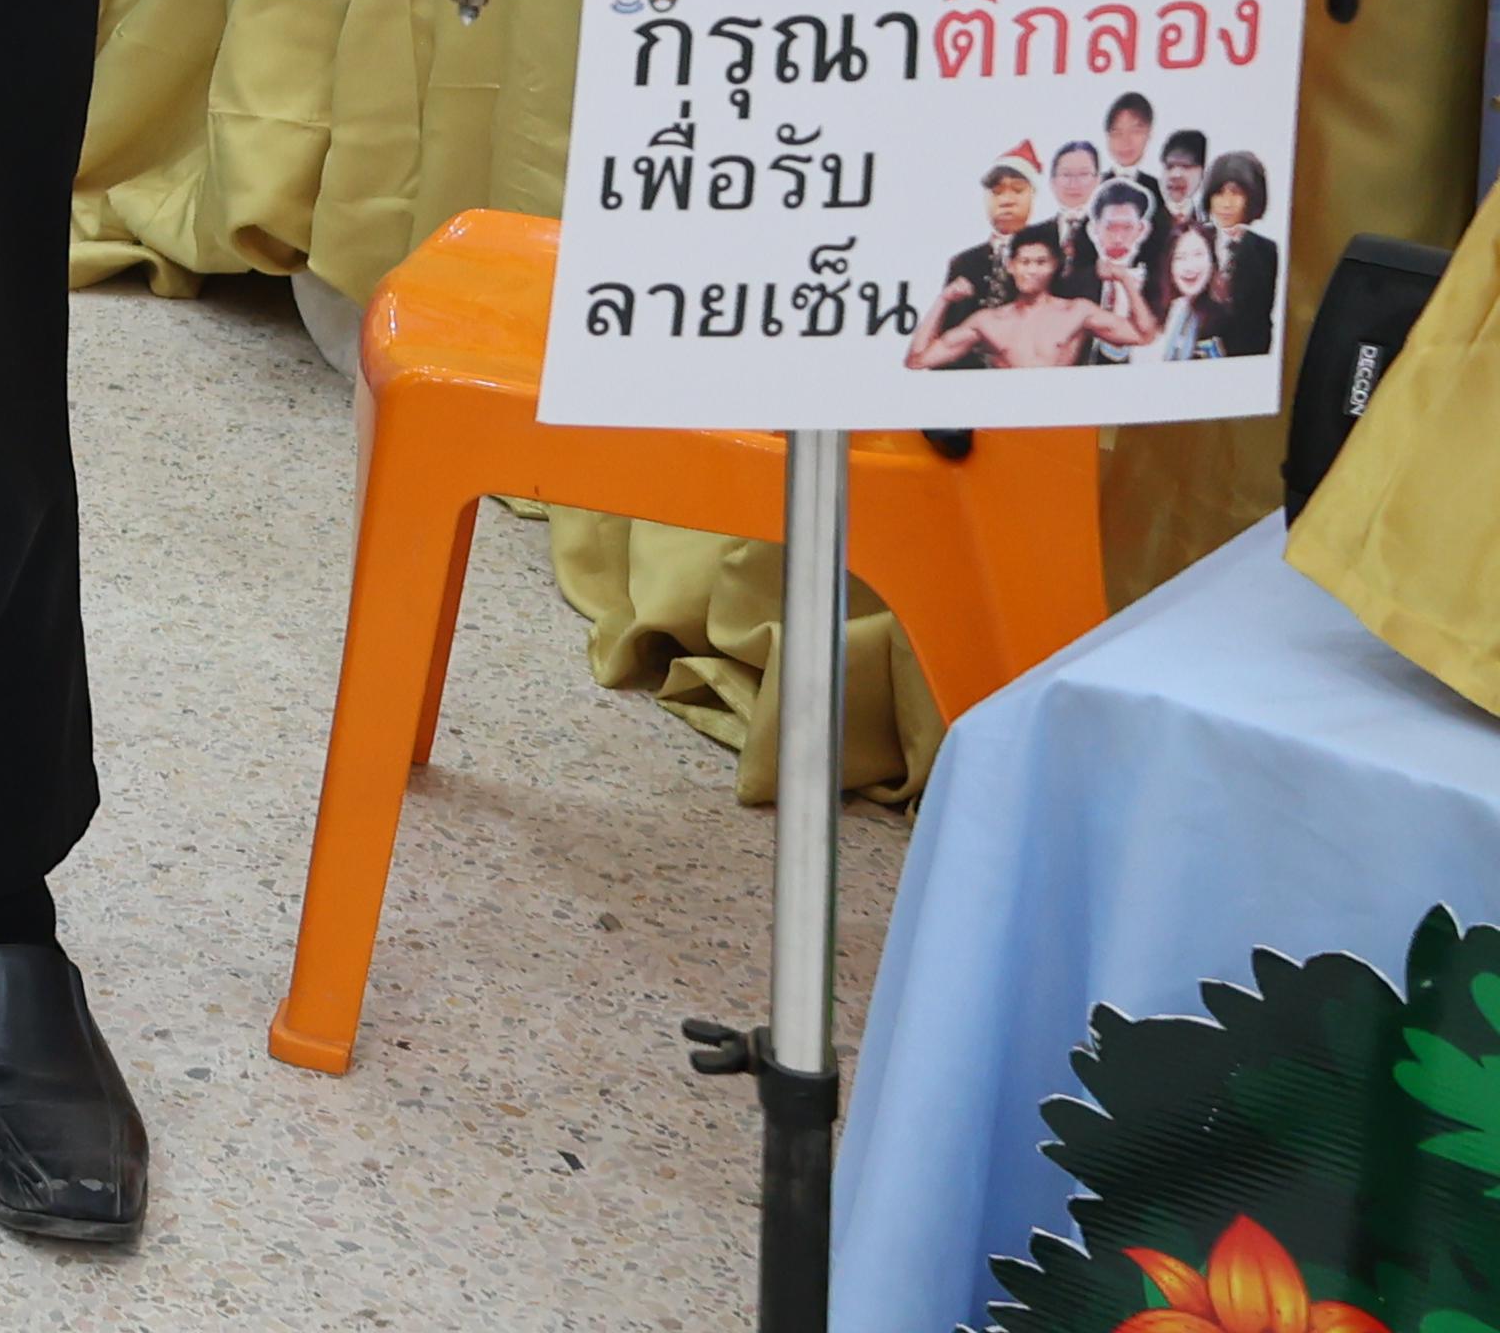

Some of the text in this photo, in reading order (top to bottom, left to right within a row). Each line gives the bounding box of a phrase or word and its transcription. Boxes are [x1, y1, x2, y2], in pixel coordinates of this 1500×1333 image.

[600, 99, 875, 211] เพื่อรับ
[585, 236, 919, 338] ลายเซ็น
[1350, 345, 1378, 416] DECCON
